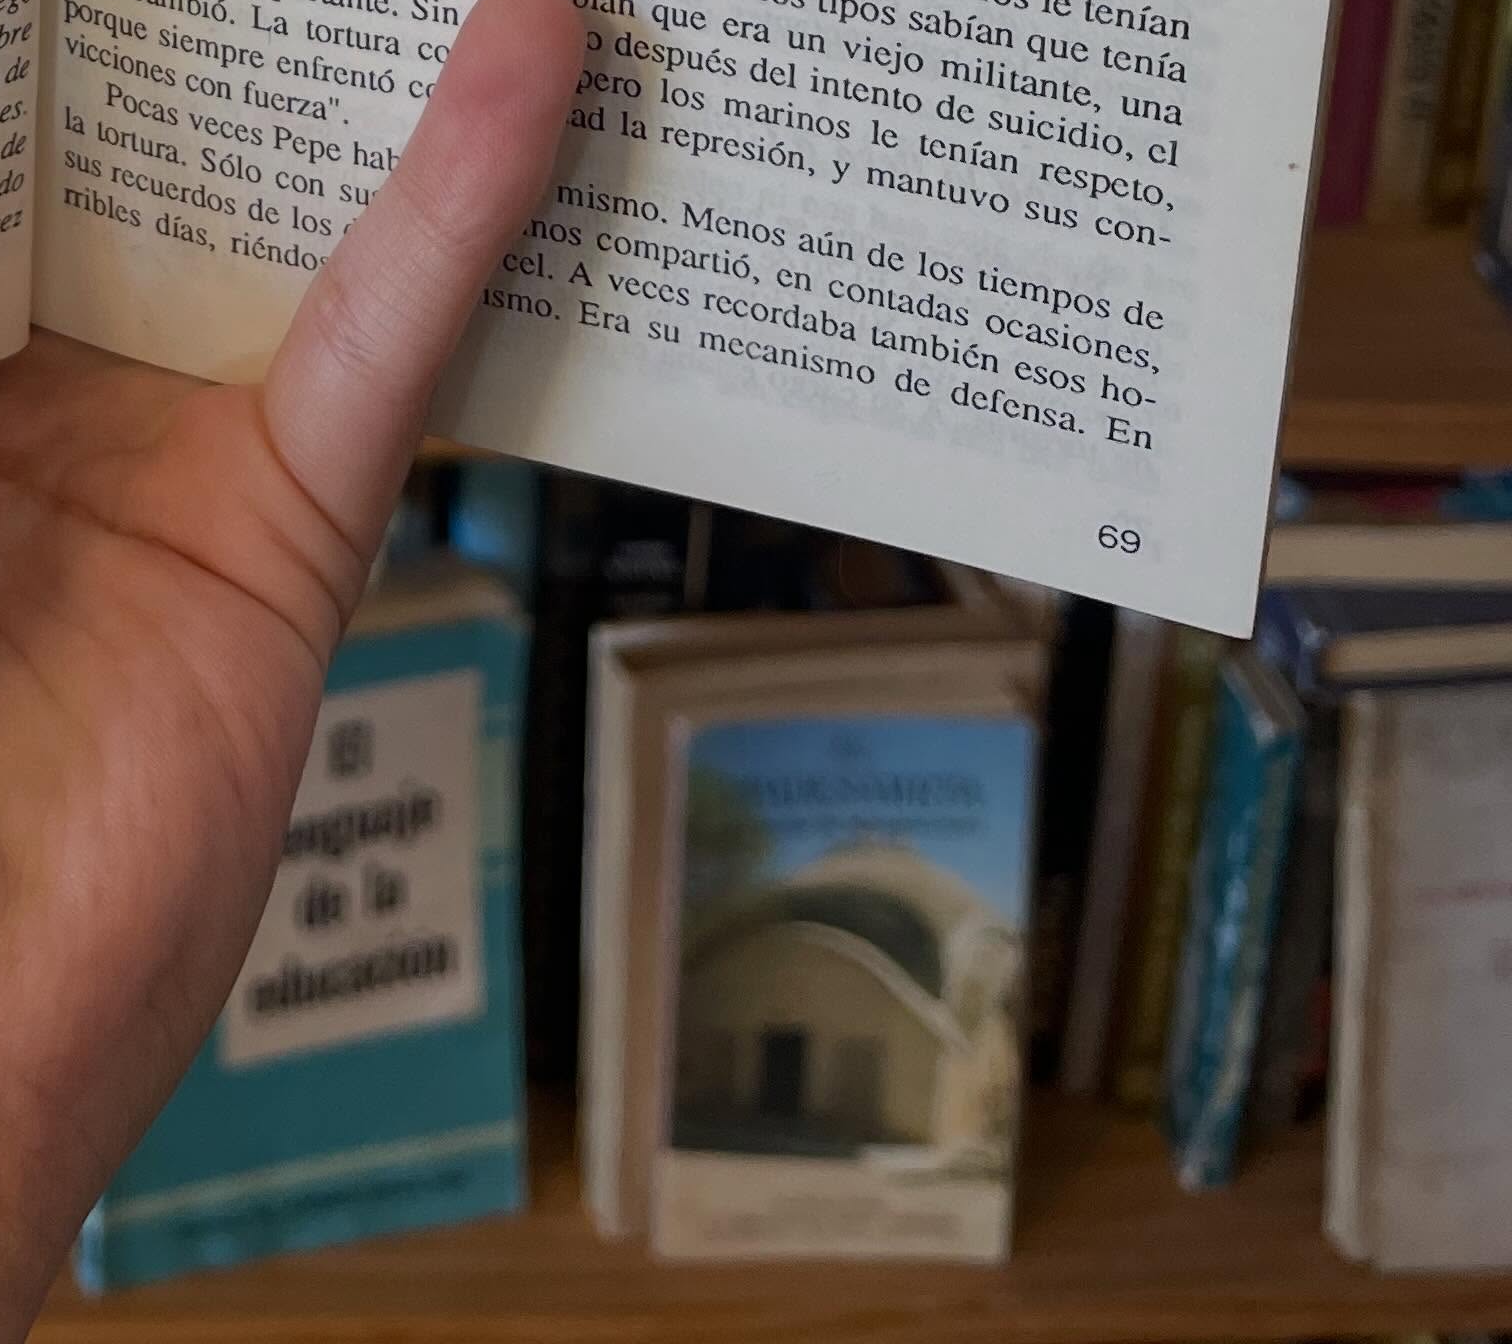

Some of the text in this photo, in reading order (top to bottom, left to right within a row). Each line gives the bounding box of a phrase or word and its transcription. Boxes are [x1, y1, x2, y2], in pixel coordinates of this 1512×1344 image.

[65, 35, 348, 124] vicciones con fuerza".
[64, 188, 141, 227] rribles
[156, 213, 215, 251] días,
[578, 300, 630, 334] Era
[648, 321, 679, 343] su
[699, 332, 875, 384] mecanismo
[895, 369, 930, 396] de
[951, 382, 1084, 434] defensa.
[1106, 416, 1151, 449] En
[1098, 525, 1140, 553] 69
